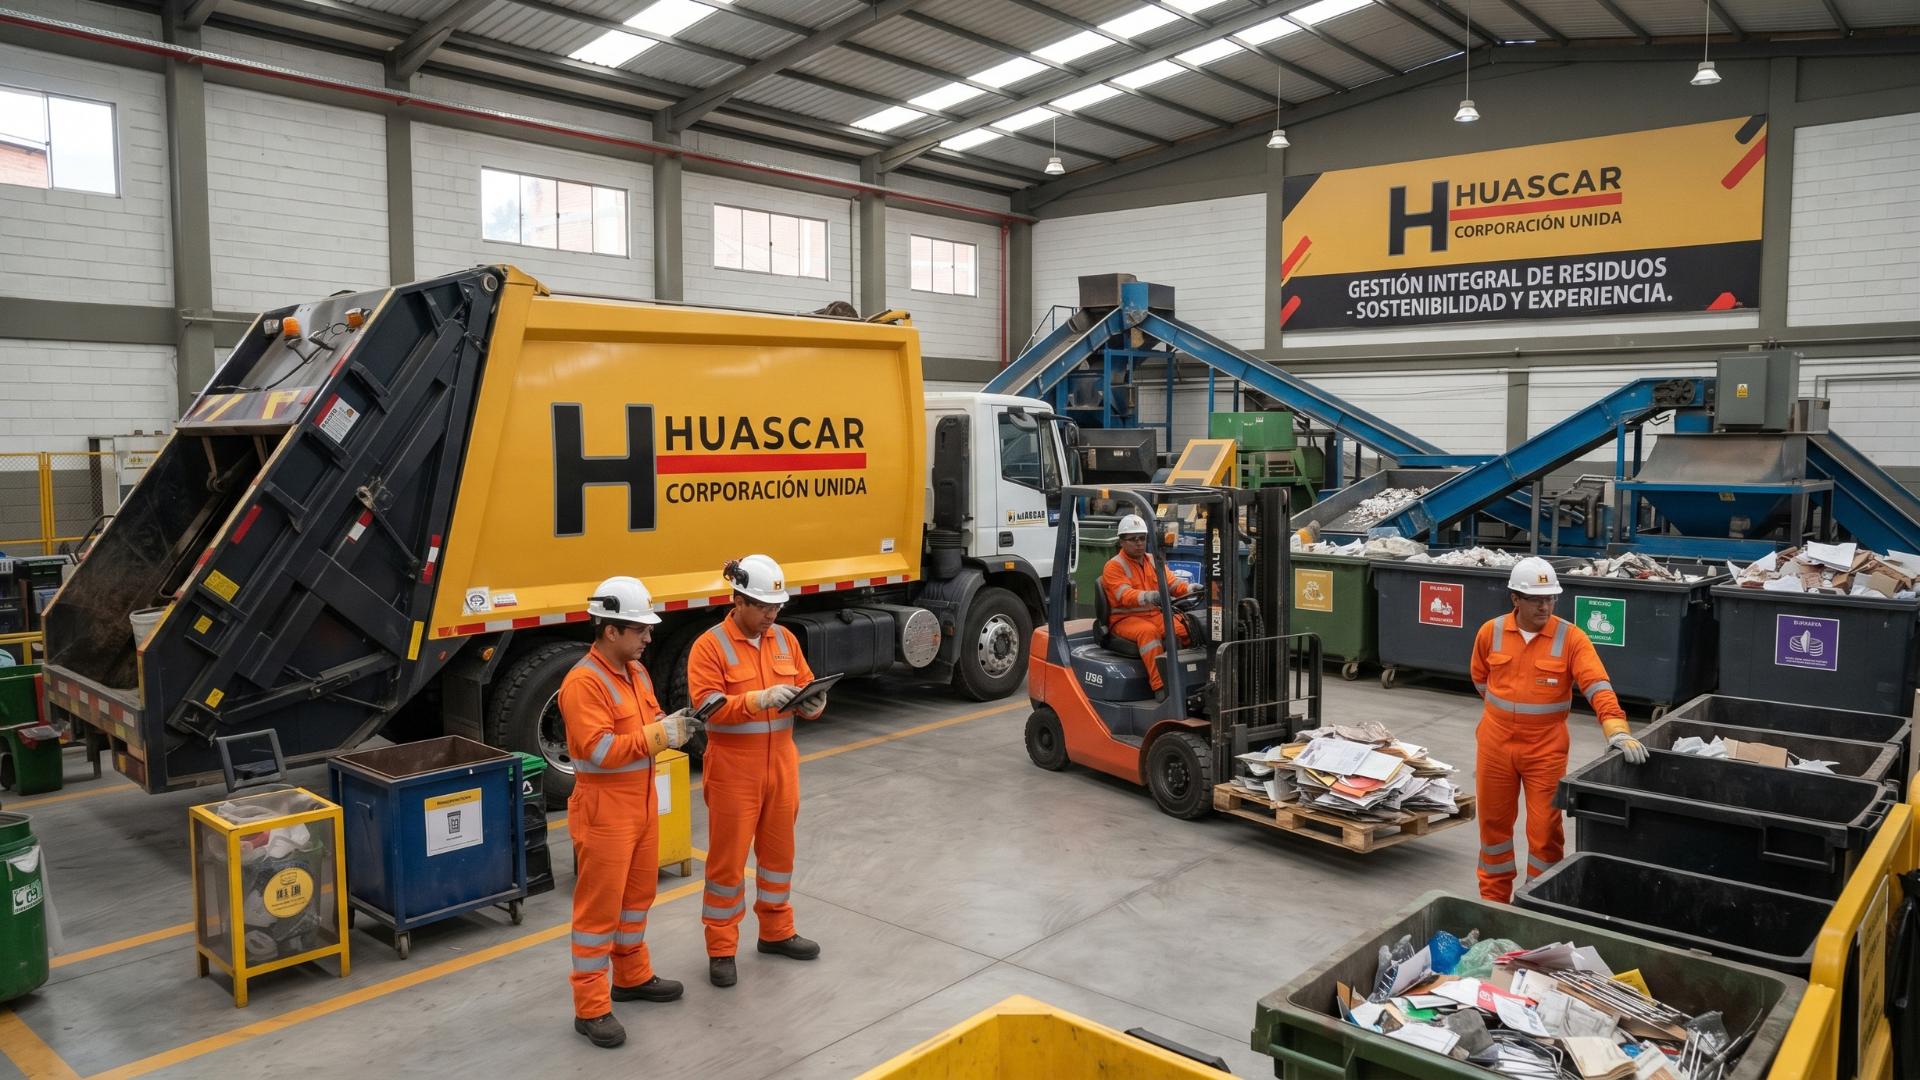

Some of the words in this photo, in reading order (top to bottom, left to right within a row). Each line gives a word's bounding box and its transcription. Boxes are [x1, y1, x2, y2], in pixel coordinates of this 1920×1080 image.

[1456, 166, 1623, 206] HUASCAR
[1388, 180, 1450, 257] H
[1454, 213, 1565, 239] CORPORACIÓN
[1570, 211, 1623, 229] UNIDA
[1348, 272, 1424, 299] GESTIÓN
[1428, 267, 1522, 293] INTEGRAL
[1527, 266, 1554, 287] DE
[1559, 257, 1667, 285] RESIDUOS
[1356, 294, 1506, 319] SOSTENIBILIDAD
[1511, 292, 1525, 310] Y
[1528, 282, 1673, 310] EXPERIENCIA.
[665, 416, 865, 451] HUASCAR
[550, 402, 657, 538] H
[665, 475, 809, 503] CORPORACIÓN
[814, 477, 867, 497] UNIDA
